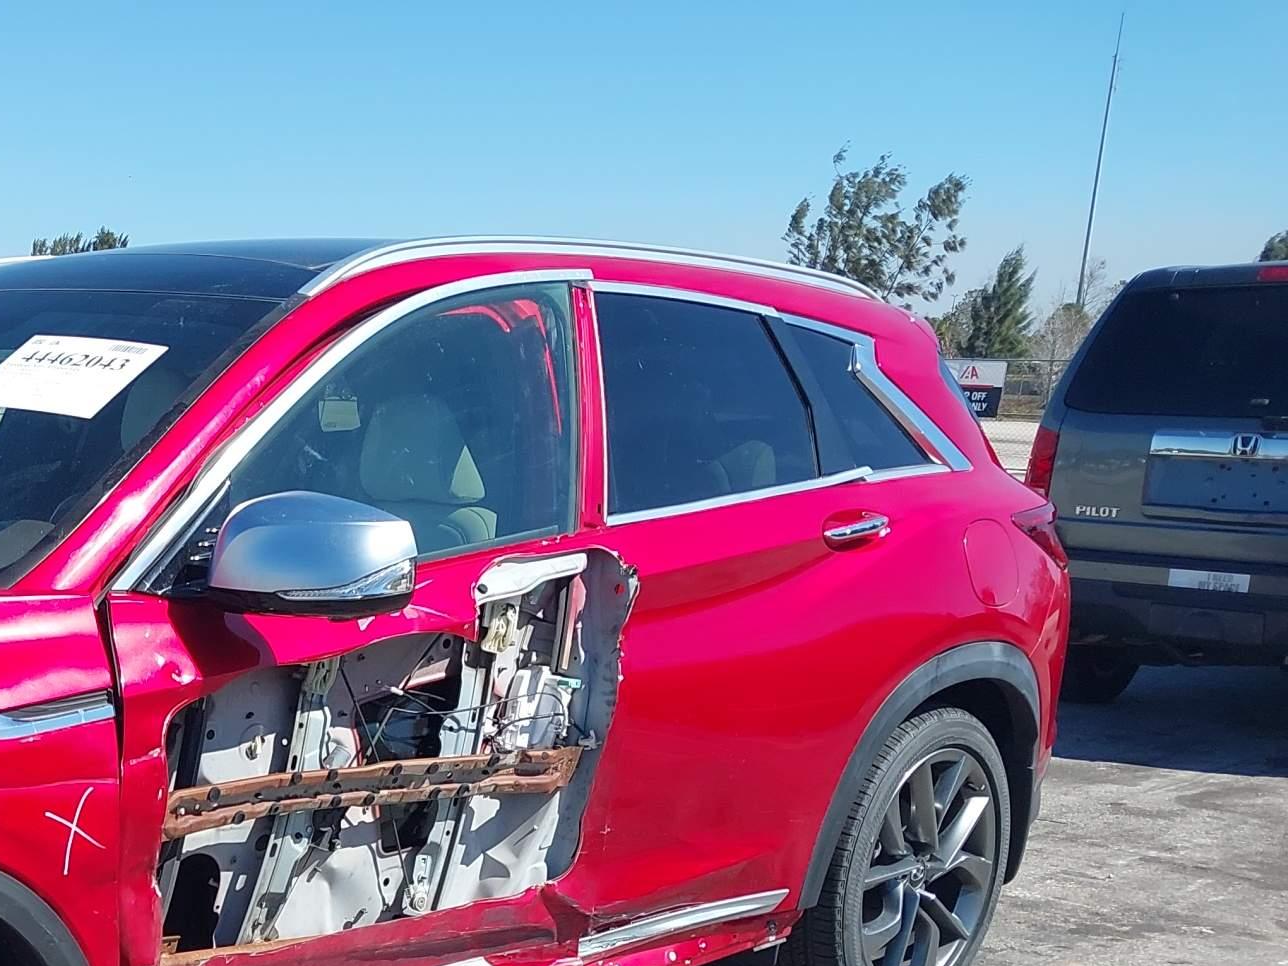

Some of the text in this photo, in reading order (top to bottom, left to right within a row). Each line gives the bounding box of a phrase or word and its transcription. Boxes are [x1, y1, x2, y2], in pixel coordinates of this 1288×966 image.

[21, 350, 130, 370] 44462043
[971, 391, 988, 401] OFF
[970, 402, 988, 411] NLY
[1075, 506, 1121, 518] PILOT
